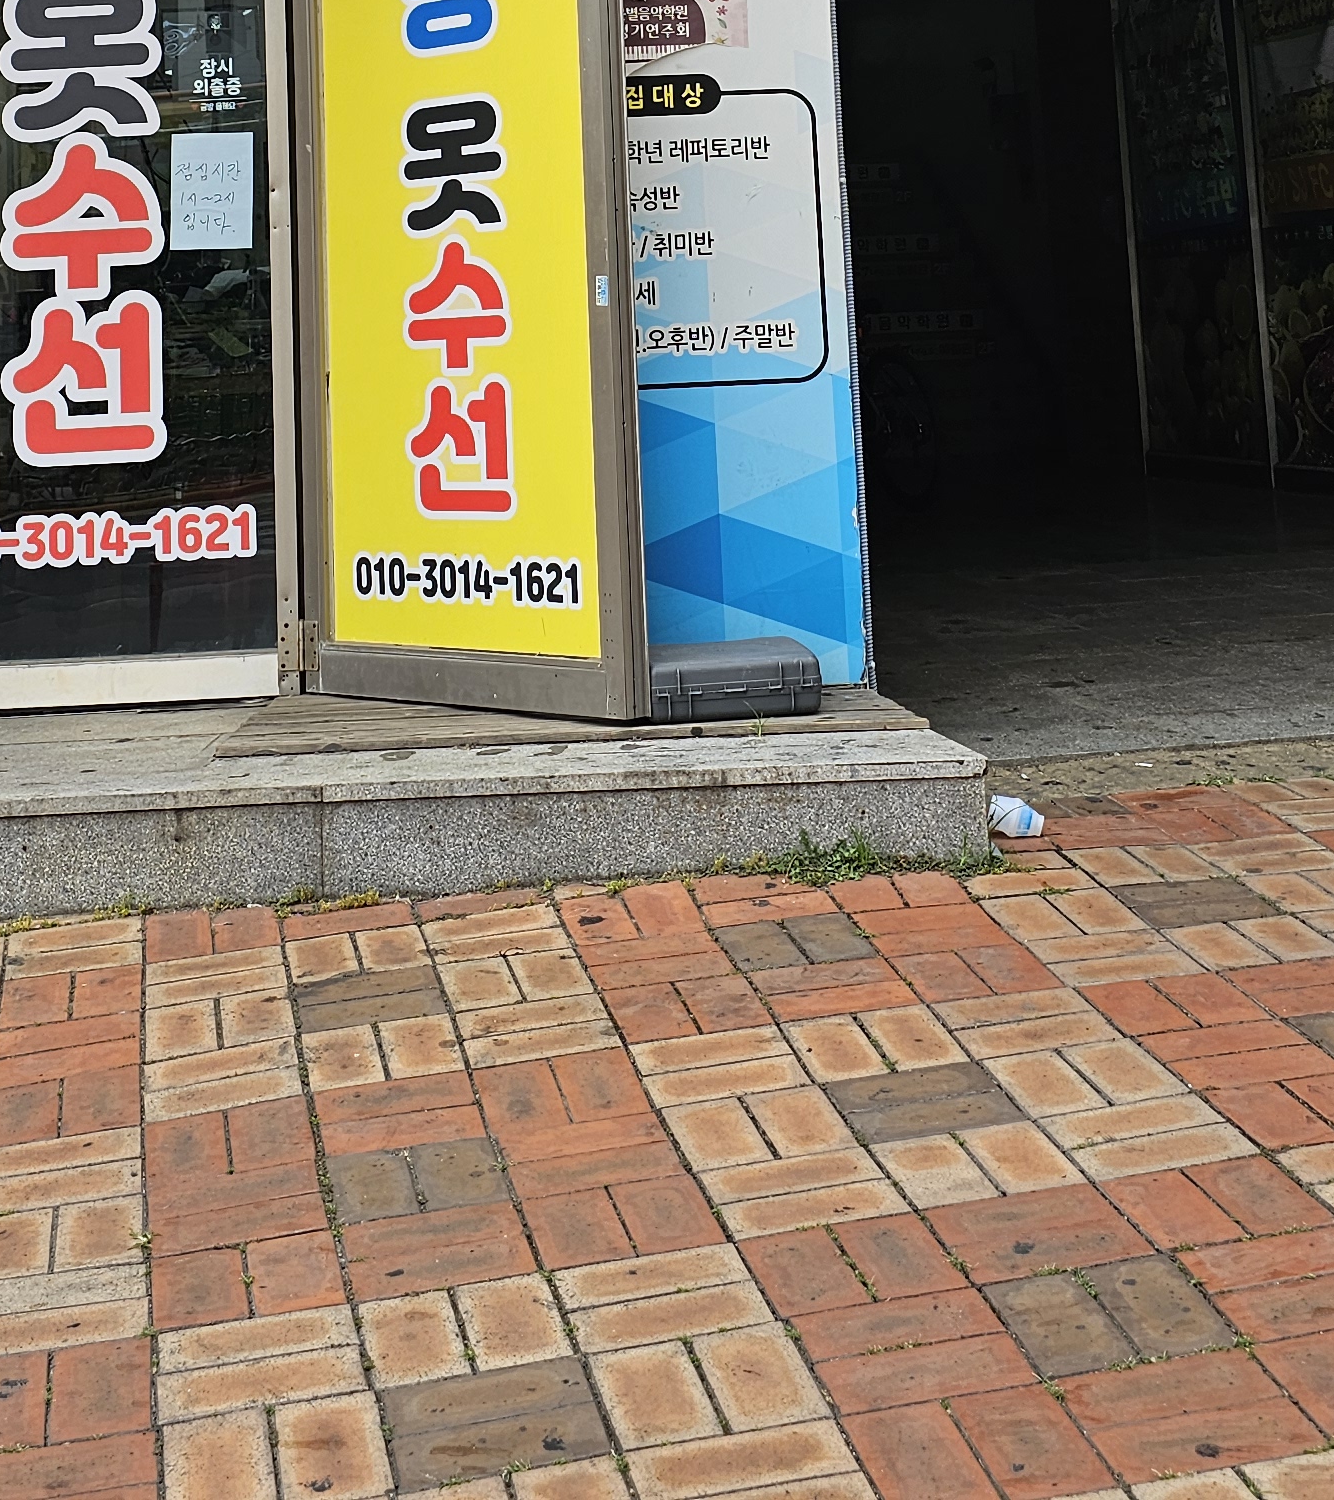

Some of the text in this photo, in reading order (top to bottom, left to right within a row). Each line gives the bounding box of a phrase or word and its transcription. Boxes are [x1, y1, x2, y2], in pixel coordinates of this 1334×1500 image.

[199, 57, 234, 77] 잠시
[669, 136, 771, 163] 레퍼토리반
[175, 160, 242, 184] 점심시간
[653, 230, 714, 257] 취미반
[403, 99, 513, 513] 옷수선
[733, 322, 796, 350] 주말반
[354, 556, 580, 605] 010-3014-1621
